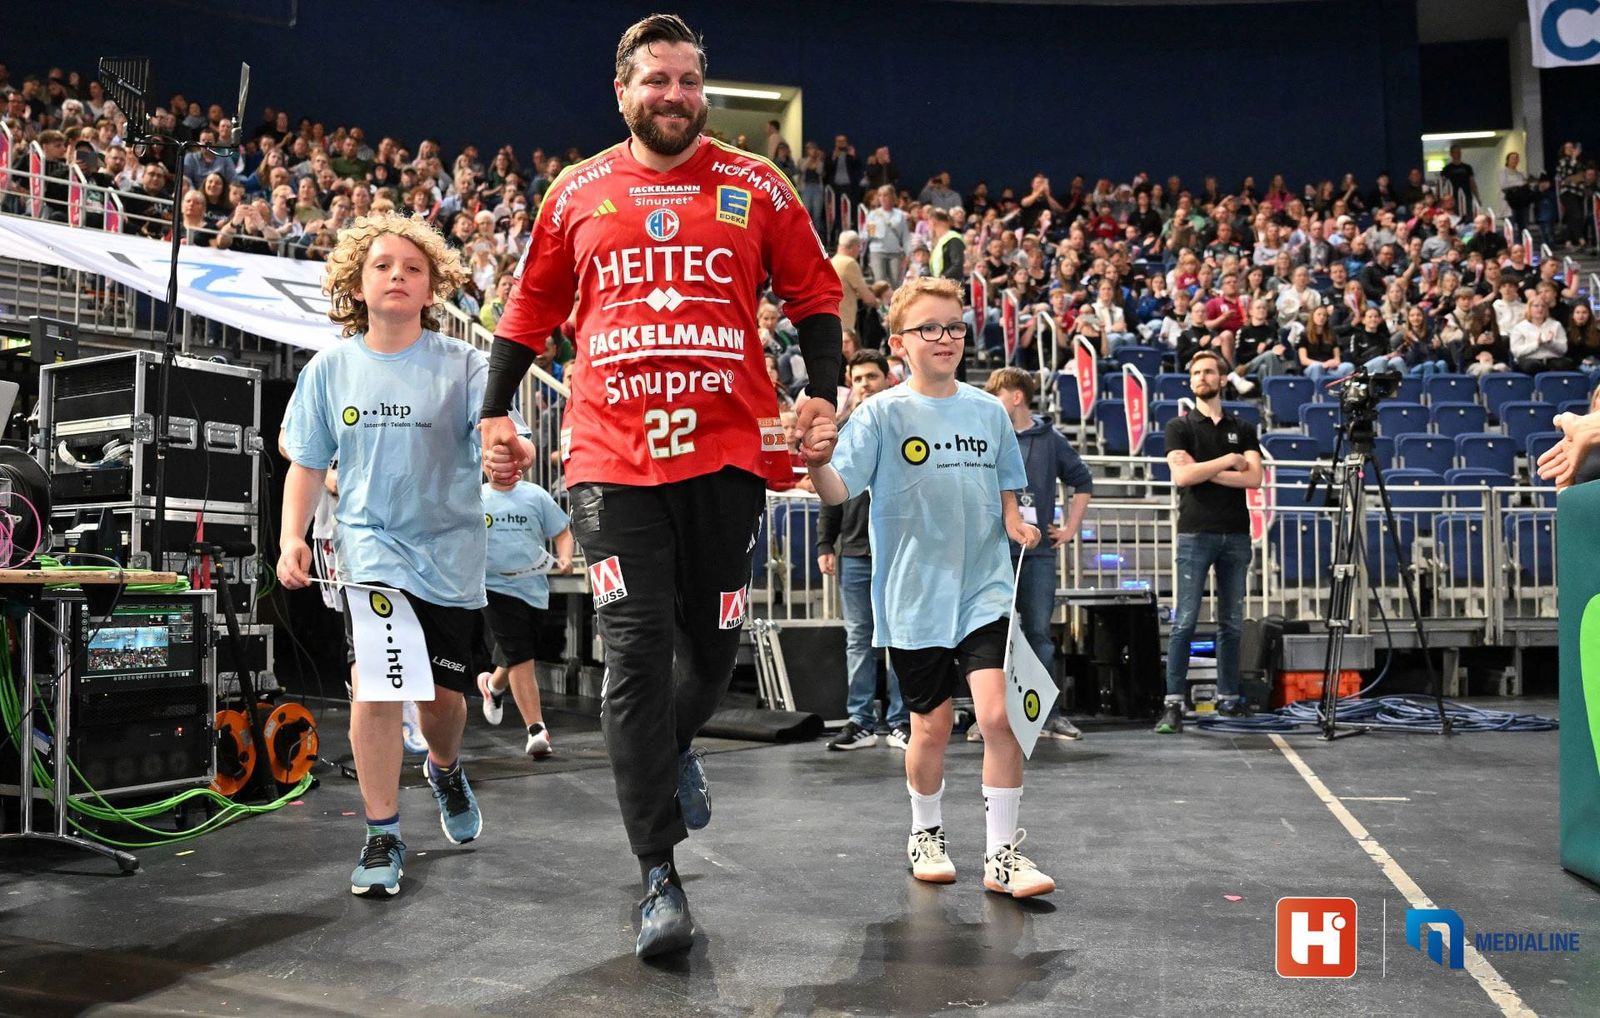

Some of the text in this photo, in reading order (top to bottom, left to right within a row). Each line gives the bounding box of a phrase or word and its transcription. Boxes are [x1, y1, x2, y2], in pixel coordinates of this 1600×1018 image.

[551, 162, 612, 228] HOFMANN
[629, 185, 701, 193] FACKELMANN
[711, 161, 786, 212] HOFMANN
[720, 213, 746, 225] EDEKA
[593, 246, 733, 290] HEITEC
[589, 323, 745, 358] FACKELMANN
[380, 402, 412, 418] htp
[644, 408, 697, 459] 22
[955, 434, 988, 457] htp
[507, 513, 528, 526] htp
[595, 588, 625, 606] AUSS
[386, 648, 404, 689] htp
